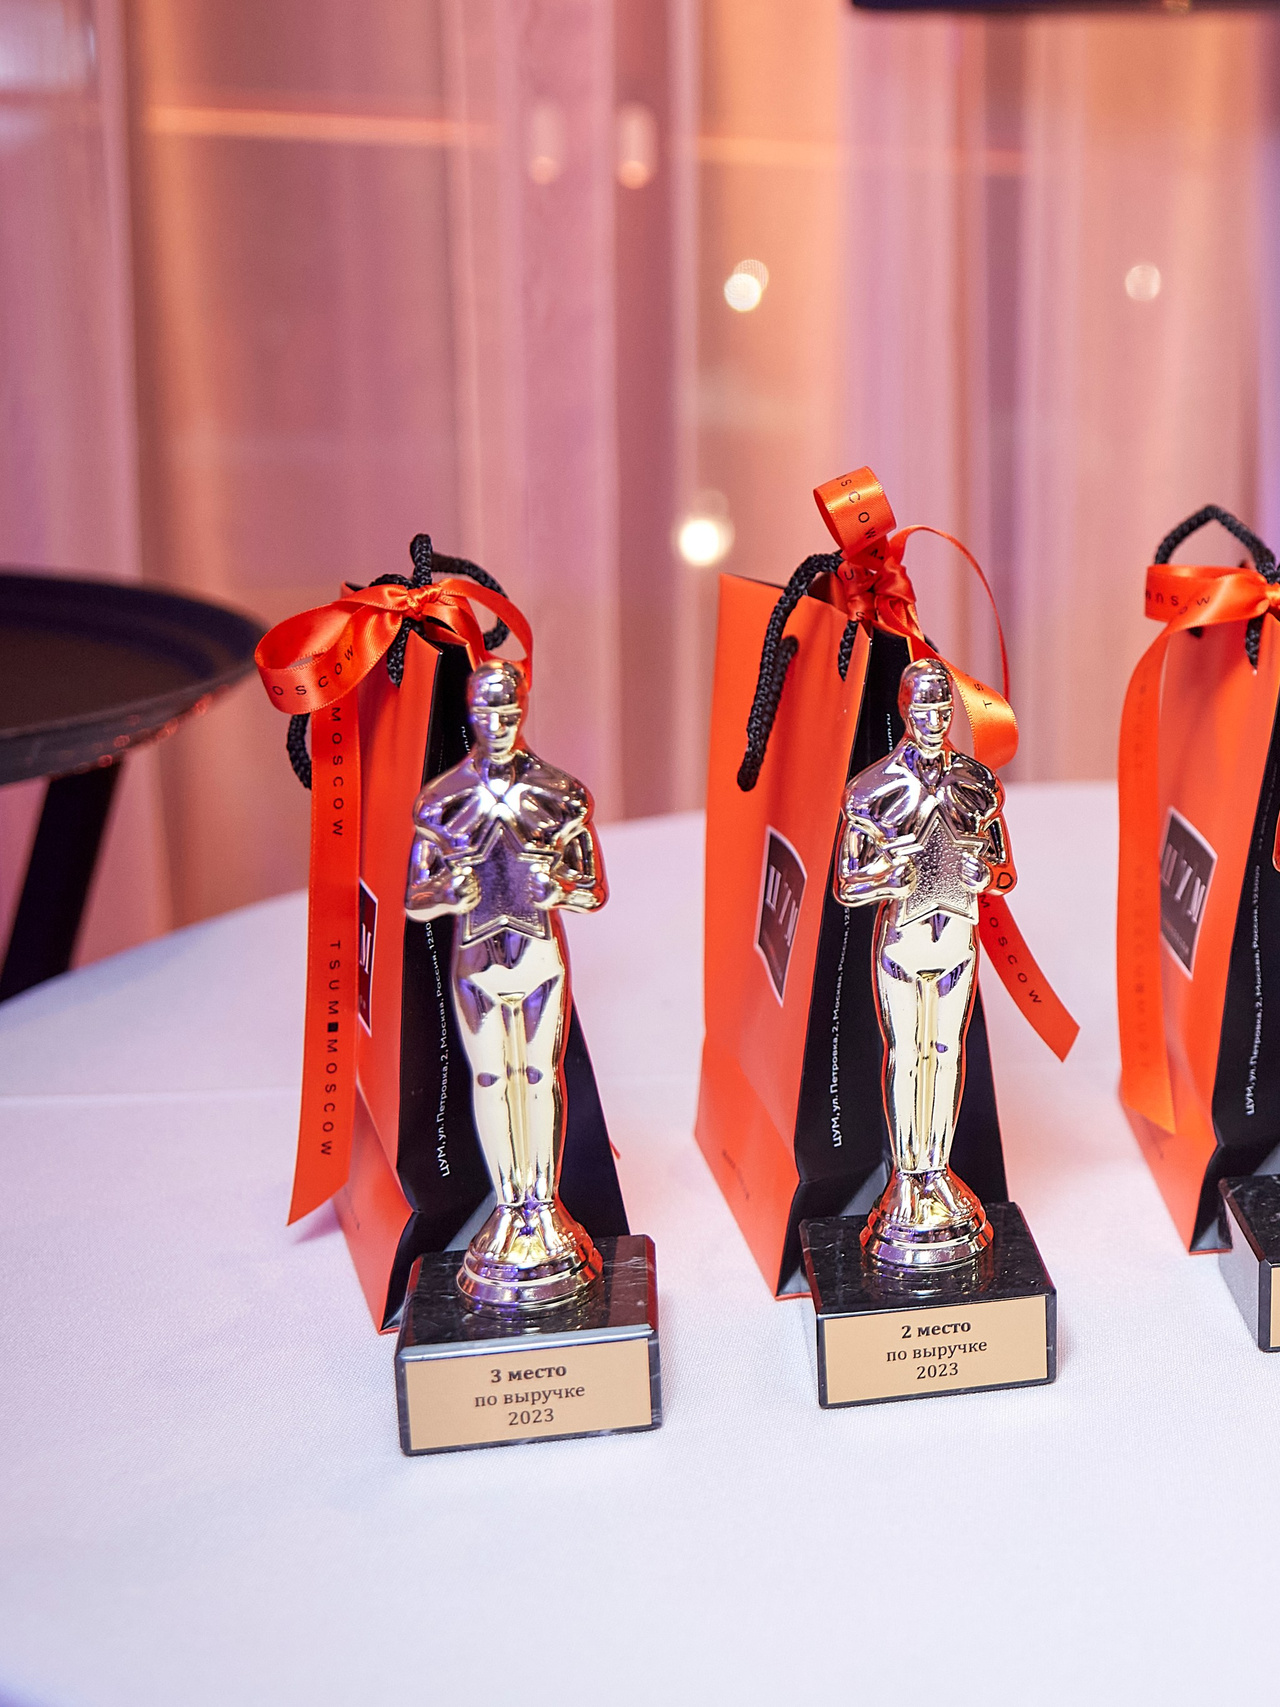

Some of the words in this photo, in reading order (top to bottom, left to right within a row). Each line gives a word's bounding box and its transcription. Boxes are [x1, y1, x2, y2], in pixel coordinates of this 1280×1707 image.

[271, 644, 355, 697] OSCOW
[331, 706, 345, 837] MOSCOW
[979, 893, 1043, 1004] MOSCOW
[327, 940, 341, 1016] TSUM
[829, 1034, 841, 1095] Петровка,
[320, 1038, 339, 1156] MOSCOW
[436, 1062, 449, 1122] Петровка,
[830, 1113, 843, 1148] ЦУМ,
[436, 1143, 451, 1177] ЦУМ,
[901, 1325, 912, 1339] 2
[917, 1322, 972, 1338] место
[886, 1350, 907, 1362] по
[912, 1341, 988, 1360] выручке
[490, 1368, 502, 1384] 3
[508, 1365, 568, 1382] место
[916, 1362, 959, 1380] 2023
[474, 1395, 498, 1408] по
[503, 1385, 586, 1406] выручке
[508, 1408, 554, 1427] 2023
